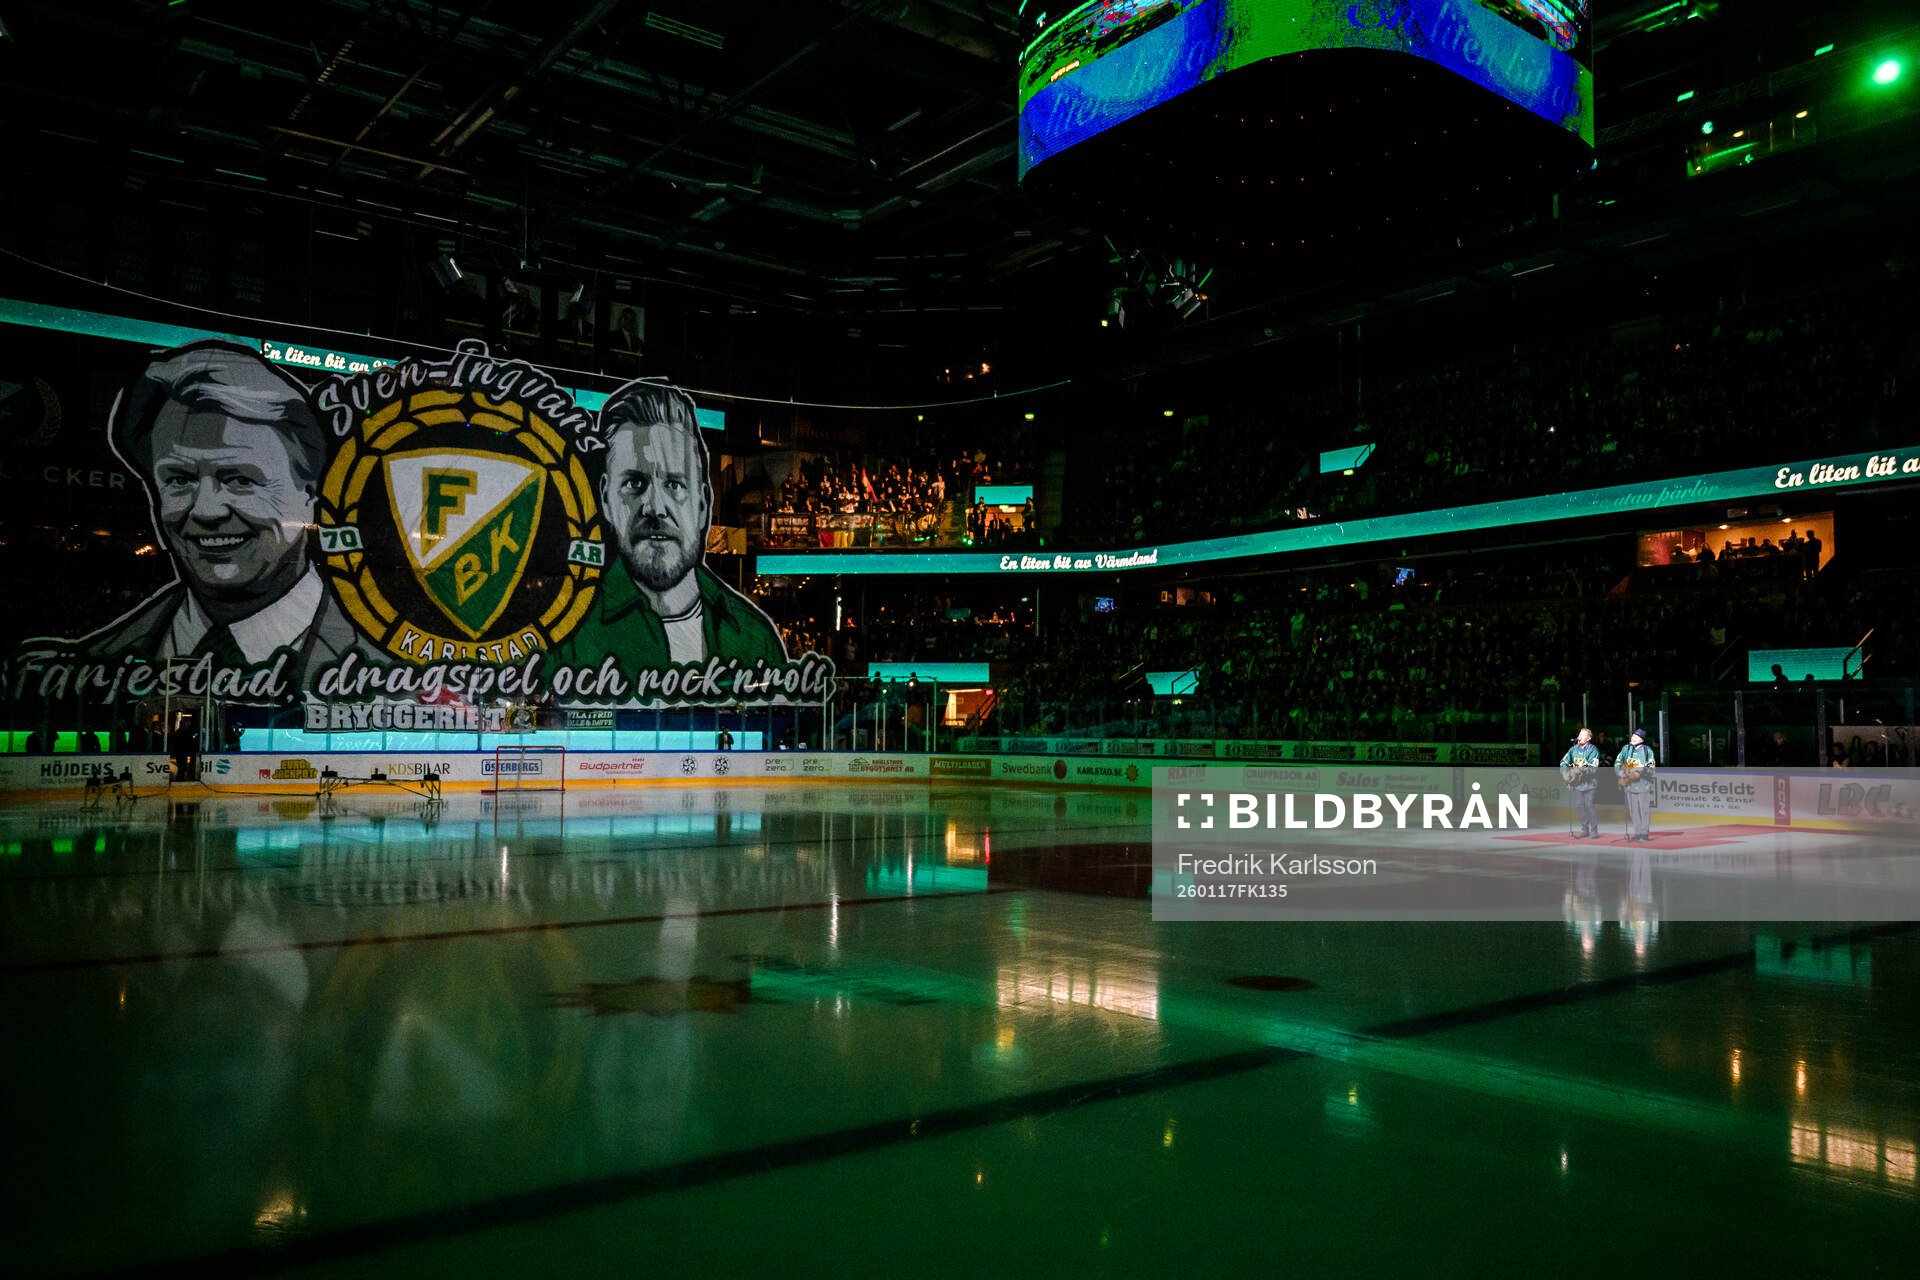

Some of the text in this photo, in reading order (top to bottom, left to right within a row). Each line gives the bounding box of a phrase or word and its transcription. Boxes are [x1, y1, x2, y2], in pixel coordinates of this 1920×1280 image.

[285, 347, 321, 366] liten
[325, 353, 346, 370] bit
[318, 346, 606, 453] Sven-Ingvars
[1774, 467, 1804, 488] En
[1809, 463, 1860, 484] liten
[1865, 455, 1897, 477] bit
[322, 530, 357, 550] 70
[571, 540, 602, 563] ÅR
[1000, 555, 1018, 570] En
[1021, 555, 1050, 570] liten
[1053, 554, 1071, 569] bit
[1074, 558, 1092, 569] av
[552, 656, 628, 695] och
[638, 655, 827, 697] rock'n'roll
[307, 703, 505, 730] BRYGGERIET
[41, 760, 114, 777] HÖJDENS
[579, 762, 644, 771] Budpartner
[1002, 762, 1051, 775] Swedbank
[1077, 766, 1123, 777] KARLSTAD.SE
[1661, 780, 1755, 795] Mossfeldt
[1778, 779, 1786, 816] CCM
